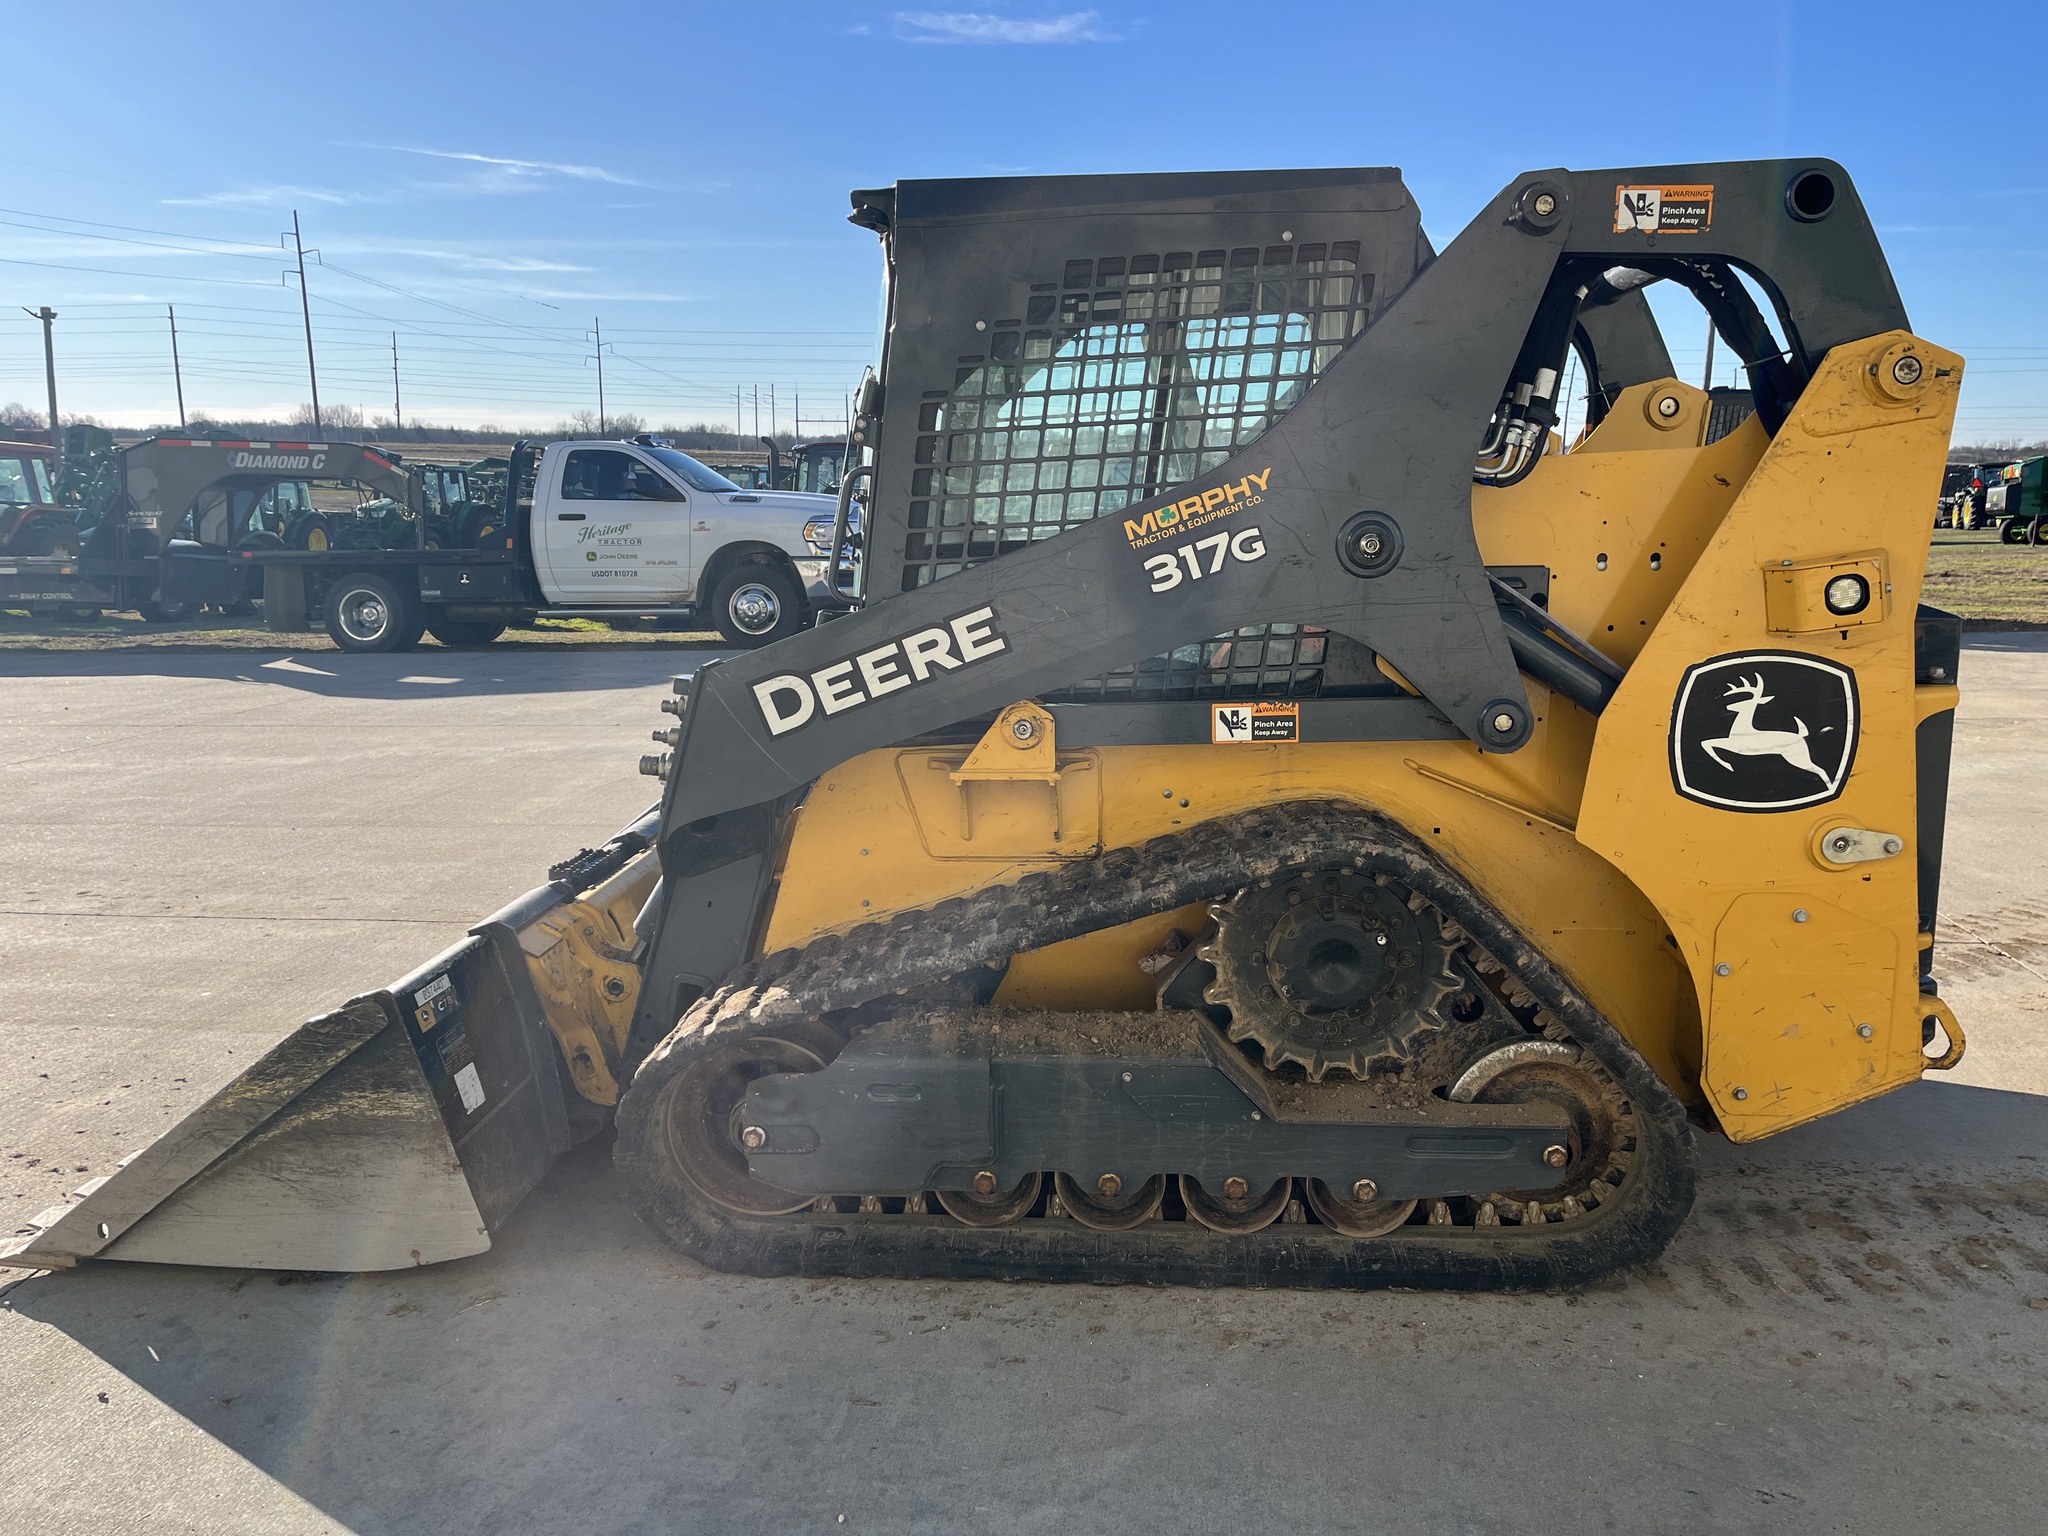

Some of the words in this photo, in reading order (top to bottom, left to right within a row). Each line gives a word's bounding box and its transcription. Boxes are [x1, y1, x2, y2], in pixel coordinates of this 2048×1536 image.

[1673, 190, 1709, 198] WARNING
[1662, 207, 1688, 215] Pinch
[1689, 207, 1706, 215] Area
[1661, 217, 1679, 225] Keep
[1680, 217, 1699, 225] Away
[235, 452, 310, 469] DIAMOND
[312, 453, 326, 470] C
[1123, 467, 1272, 541] MURPHY
[1130, 527, 1176, 550] TRACTOR
[1178, 523, 1186, 533] &
[1187, 502, 1244, 530] EQUIPMENT
[1246, 495, 1264, 507] CO.
[577, 523, 632, 544] Heritage
[1143, 527, 1267, 593] 317G
[20, 592, 41, 600] SWAY
[42, 592, 74, 600] CONTROL
[752, 606, 1006, 736] DEERE
